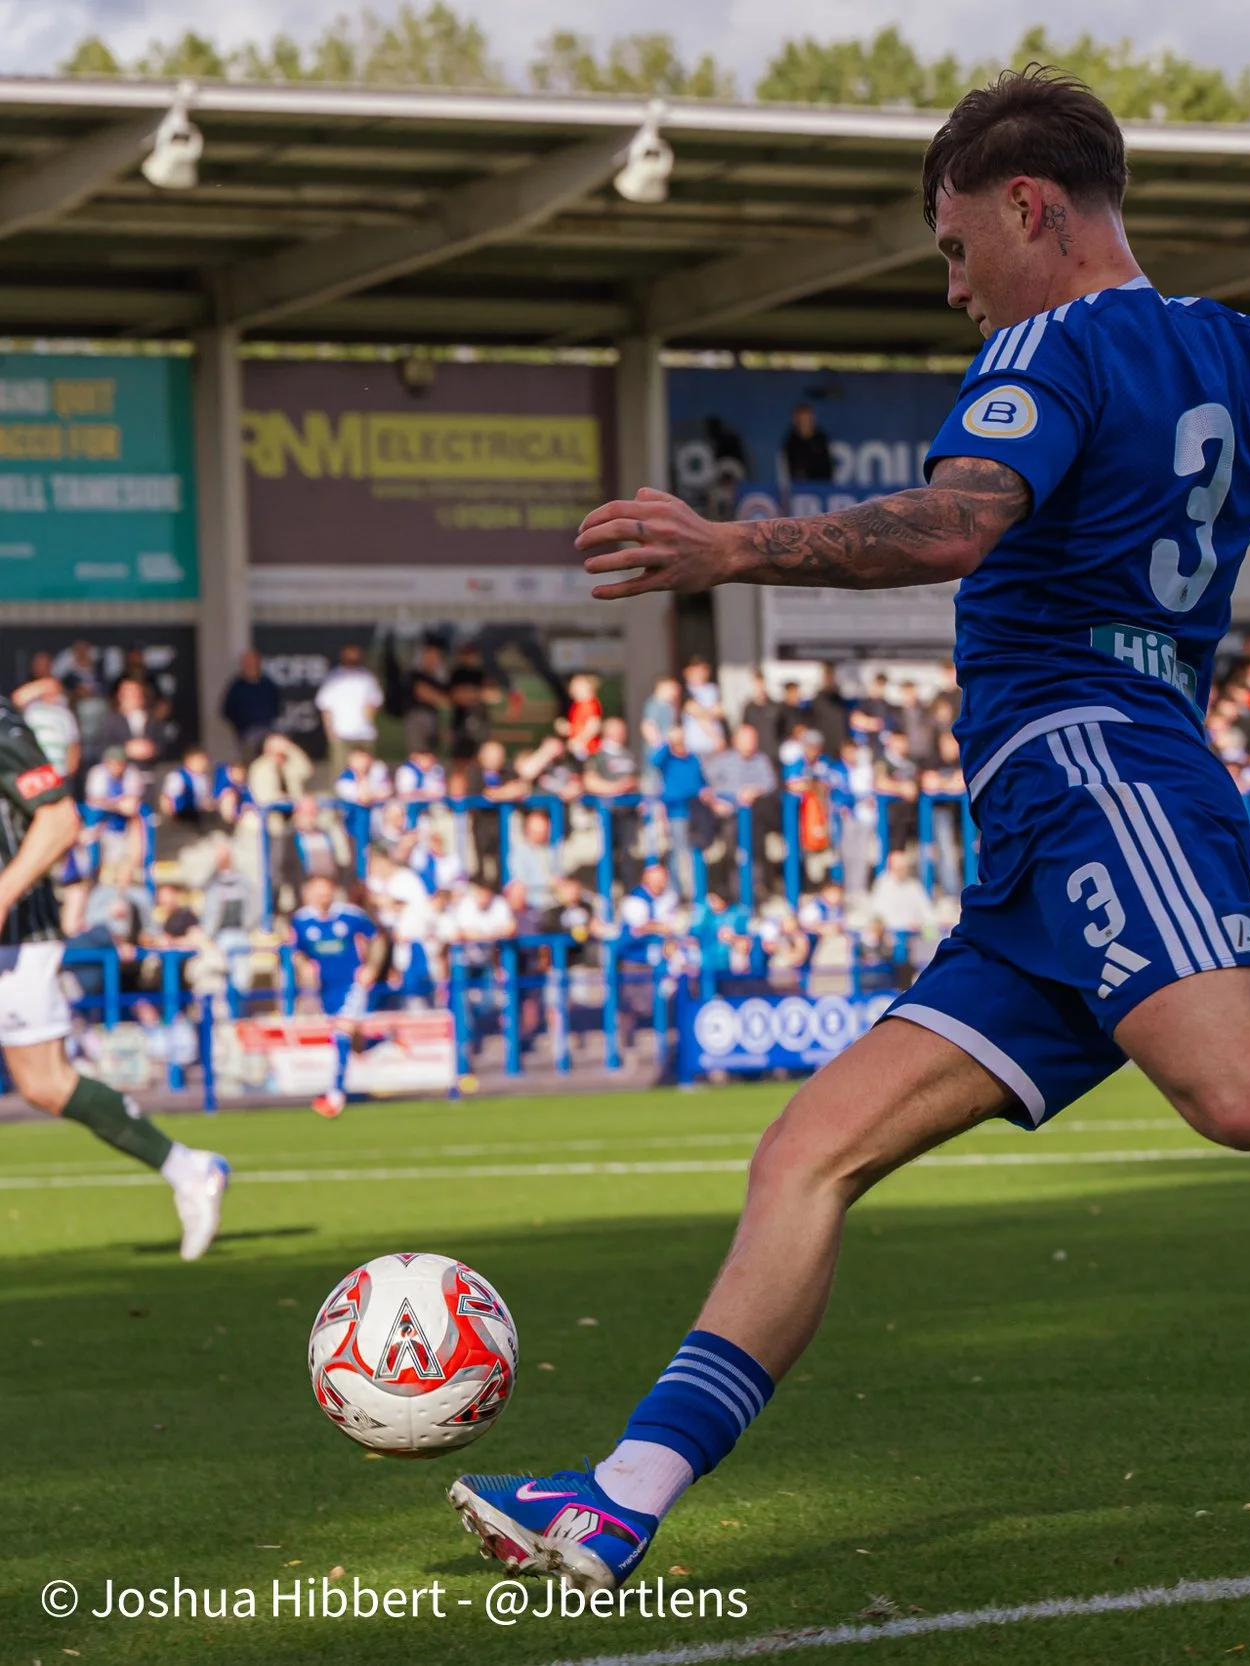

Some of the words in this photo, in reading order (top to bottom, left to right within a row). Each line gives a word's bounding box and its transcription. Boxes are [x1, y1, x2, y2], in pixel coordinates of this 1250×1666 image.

[982, 401, 1017, 424] B
[1149, 402, 1235, 612] 3
[1066, 861, 1126, 948] 3
